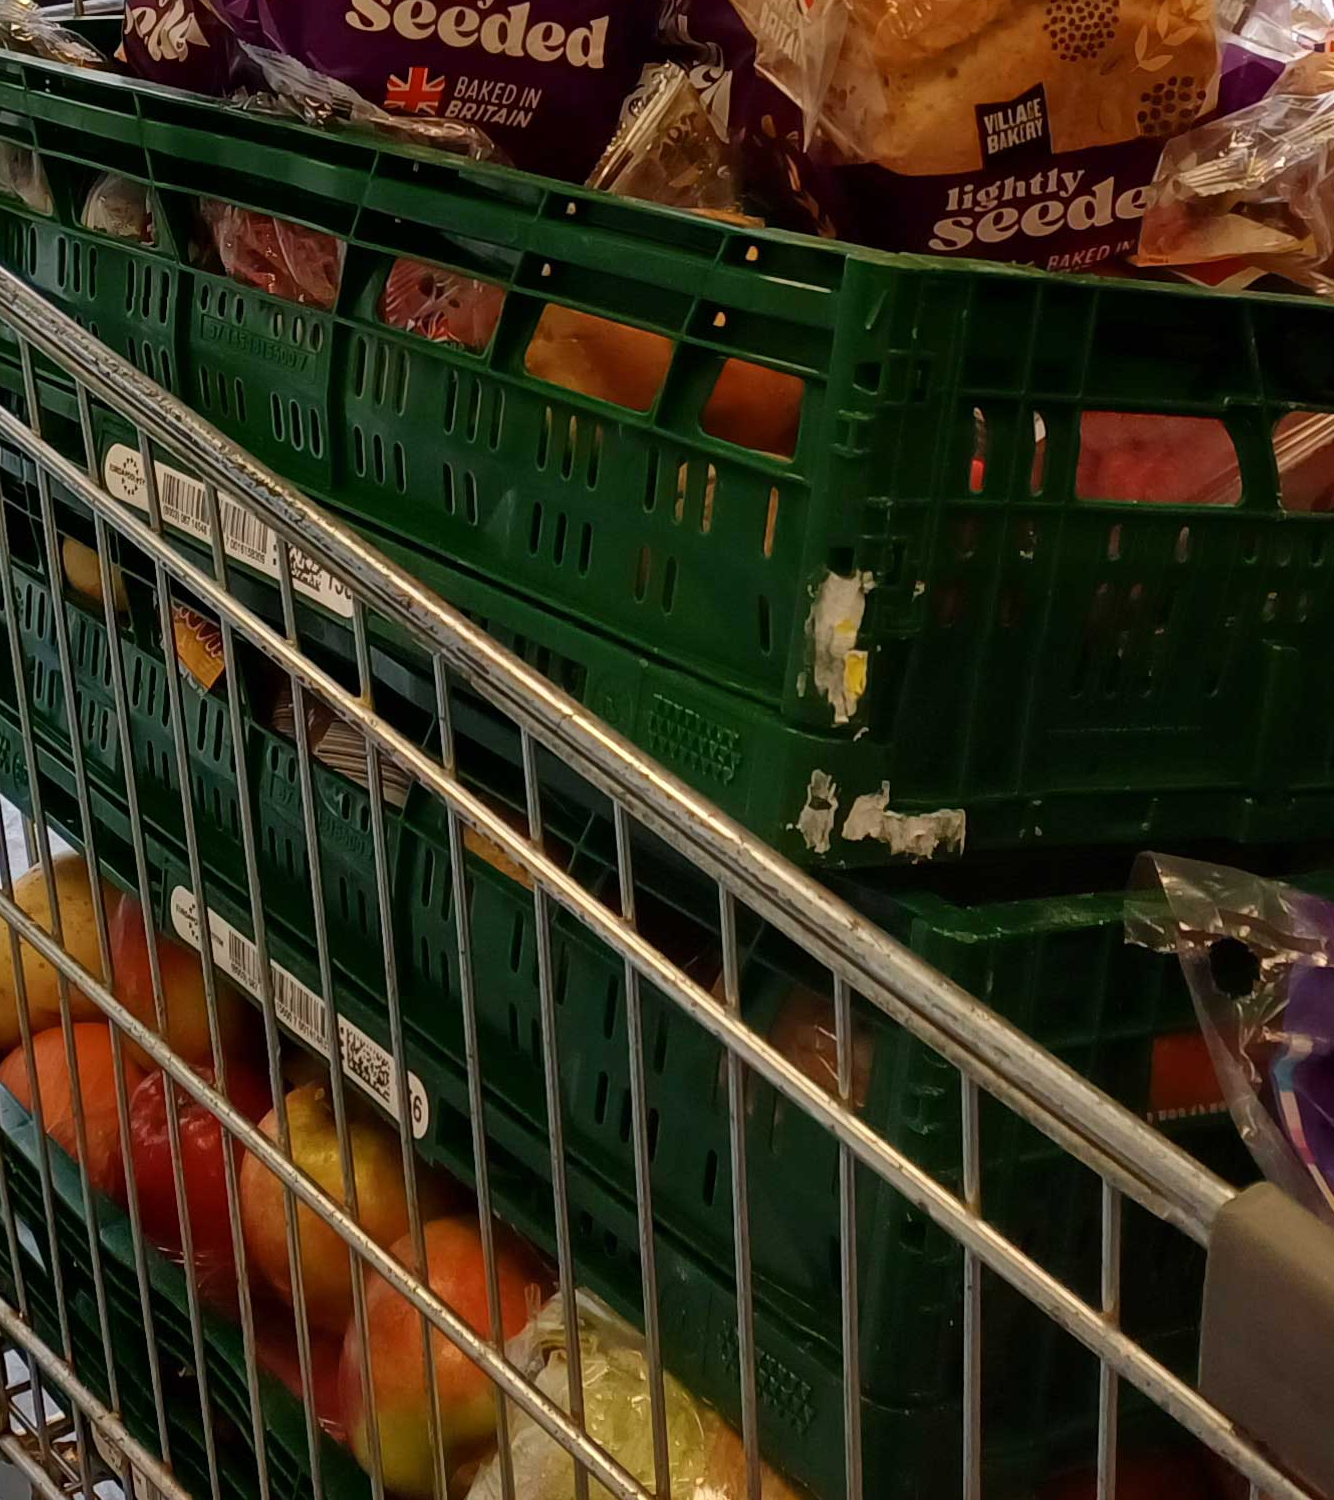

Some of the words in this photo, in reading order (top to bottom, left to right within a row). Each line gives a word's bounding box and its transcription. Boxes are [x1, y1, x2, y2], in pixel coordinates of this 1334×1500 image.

[454, 76, 517, 106] BAKED
[520, 87, 543, 110] IN
[444, 100, 534, 129] BRITAIN
[983, 97, 1043, 135] VILLAGE
[986, 117, 1044, 156] BAKERY
[945, 167, 1086, 212] lightly
[927, 176, 1151, 251] seede
[1046, 244, 1111, 274] BAKED
